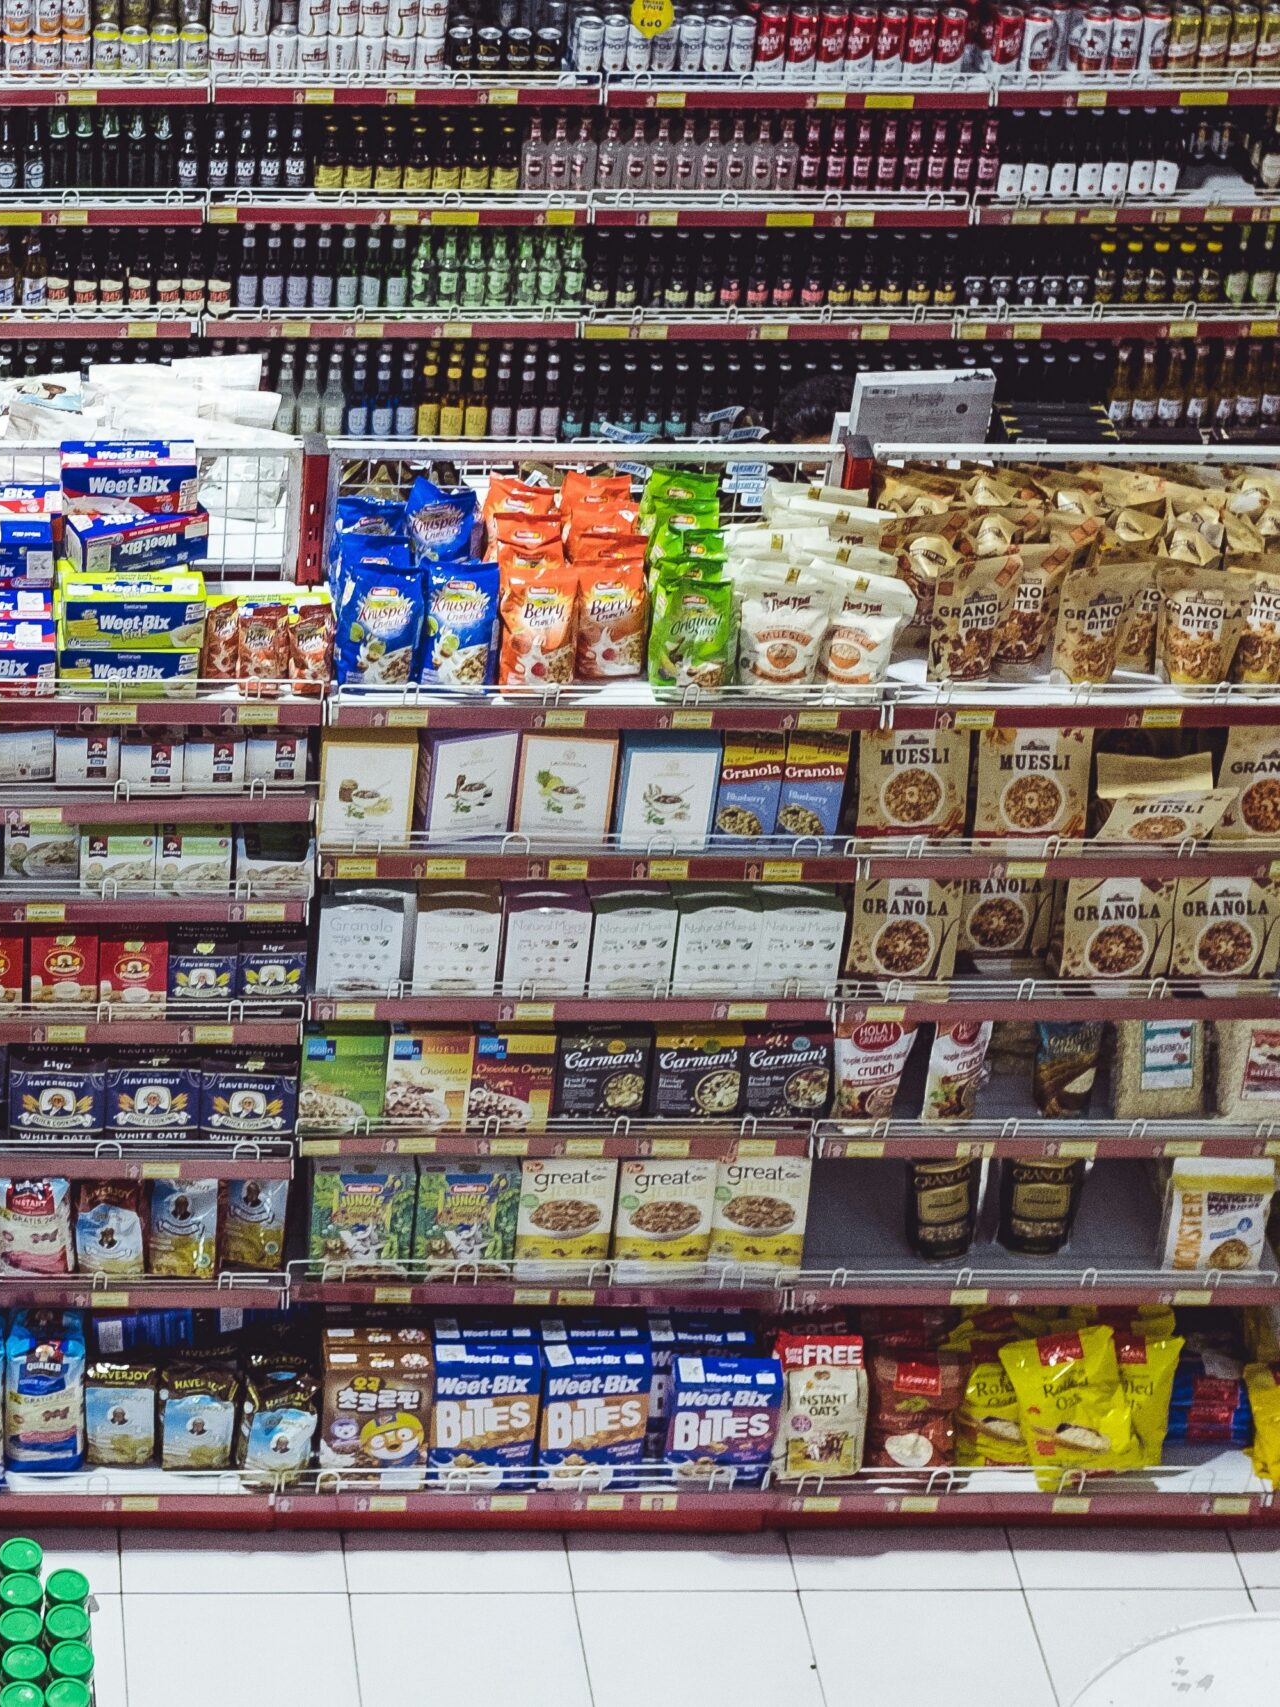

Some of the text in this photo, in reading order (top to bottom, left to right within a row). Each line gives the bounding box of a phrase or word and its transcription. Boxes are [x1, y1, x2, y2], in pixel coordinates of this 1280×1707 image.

[89, 477, 171, 493] Weet-Bix
[411, 516, 462, 533] Knusper
[359, 604, 412, 622] Knusper
[432, 599, 487, 612] Knusper
[524, 604, 564, 620] Berry
[590, 600, 633, 615] Berry
[100, 616, 170, 630] Weet-Bix
[670, 615, 723, 636] Original
[961, 616, 995, 628] BITES
[1182, 617, 1219, 630] BITES
[245, 631, 275, 644] Berry
[94, 664, 164, 679] Weet-Bix
[881, 748, 950, 765] MUESLI
[1000, 754, 1070, 770] MUESLI
[722, 764, 781, 780] Granola
[785, 765, 845, 779] Granola
[726, 792, 765, 804] Blueberry
[789, 790, 828, 804] Blueberry
[1133, 804, 1205, 815] MUESLI
[862, 899, 948, 917] GRANOLA
[1074, 905, 1161, 921] GRANOLA
[1183, 900, 1269, 917] GRANOLA
[330, 917, 393, 933] Granola
[43, 1060, 72, 1070] Ligo
[564, 1051, 643, 1070] Carman's
[659, 1051, 739, 1070] Carman's
[749, 1049, 827, 1068] Carman's
[421, 1066, 468, 1076] Chocolate
[476, 1064, 553, 1076] Chocolate Cherry
[858, 1062, 894, 1076] crunch
[28, 1080, 84, 1088] HAVERMOUT
[219, 1083, 276, 1091] HAVERMOUT
[635, 1169, 691, 1194] great
[727, 1163, 785, 1185] great
[534, 1172, 590, 1193] great
[12, 1199, 47, 1208] INSTANT
[802, 1345, 863, 1365] FREE
[26, 1362, 61, 1372] QUAKER
[437, 1375, 531, 1396] Weet-Bix
[549, 1375, 643, 1396] Weet-Bix
[705, 1373, 752, 1385] Weet-Bix
[677, 1391, 772, 1407] Weet-Bix
[800, 1393, 847, 1405] INSTANT
[809, 1406, 839, 1417] OATS
